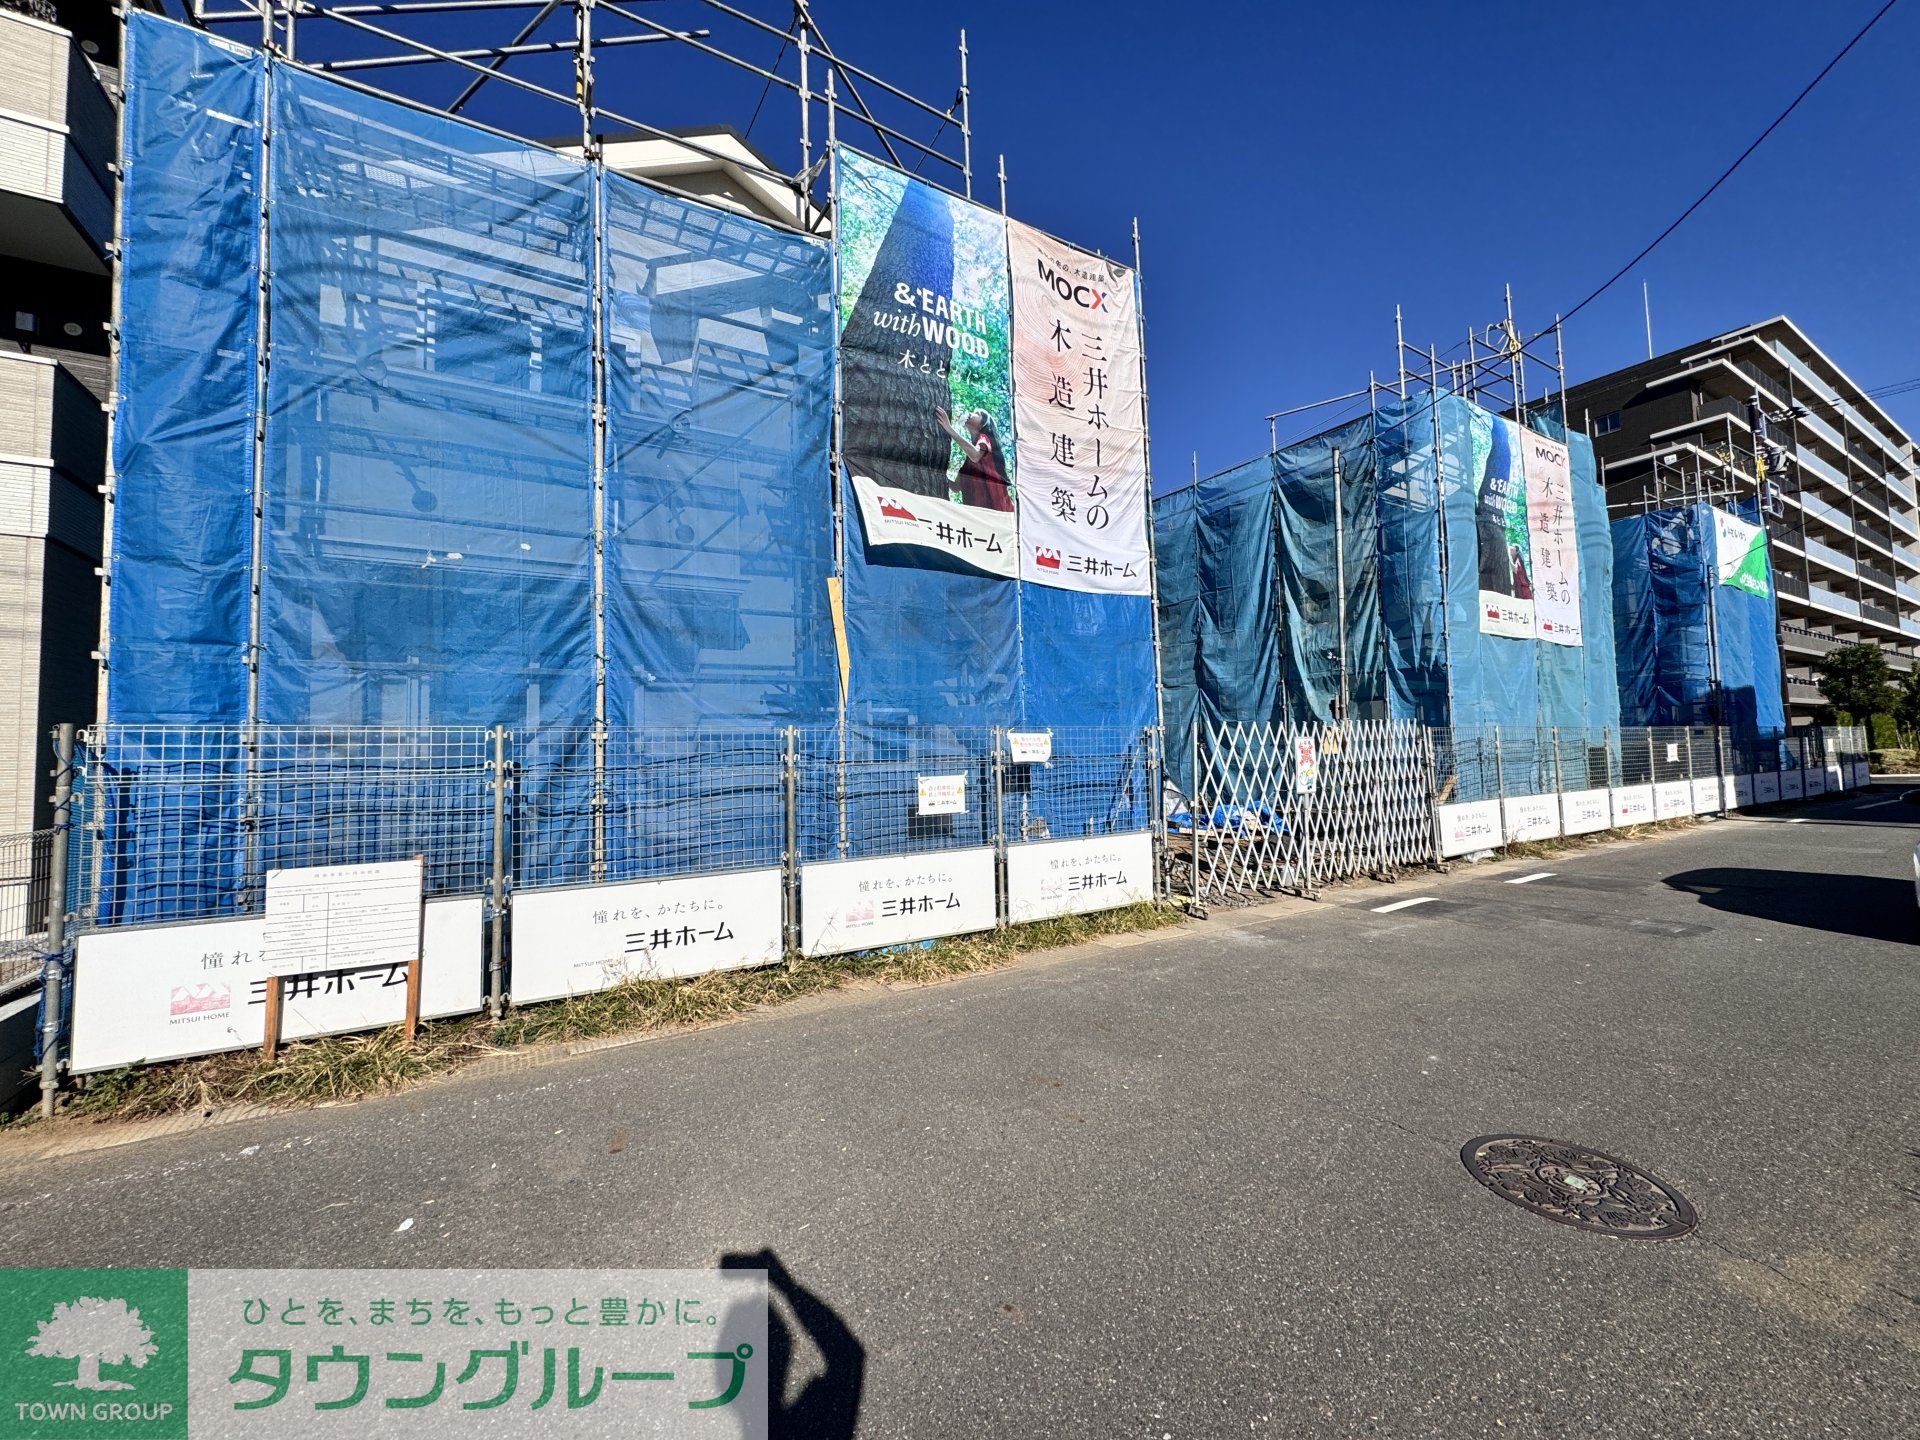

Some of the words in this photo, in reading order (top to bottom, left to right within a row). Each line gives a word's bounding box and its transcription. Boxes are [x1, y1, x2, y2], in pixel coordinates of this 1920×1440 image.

[1037, 258, 1109, 314] MOCX
[873, 309, 921, 337] with
[922, 316, 990, 359] WOOD
[1048, 319, 1076, 523] 木造建築
[1081, 333, 1110, 530] 三井ホームの
[1553, 483, 1571, 605] 三井ホームの
[1067, 555, 1137, 577] 三井ホーム
[858, 873, 953, 892] 憧れを、かたちに。
[1068, 870, 1127, 891] 三井ホーム
[592, 899, 725, 924] 憧れを、かたちに。
[881, 892, 961, 917] 三井ホーム
[624, 921, 734, 953] 三井ホーム
[169, 1015, 201, 1025] MITSUI
[203, 1011, 230, 1021] HOME
